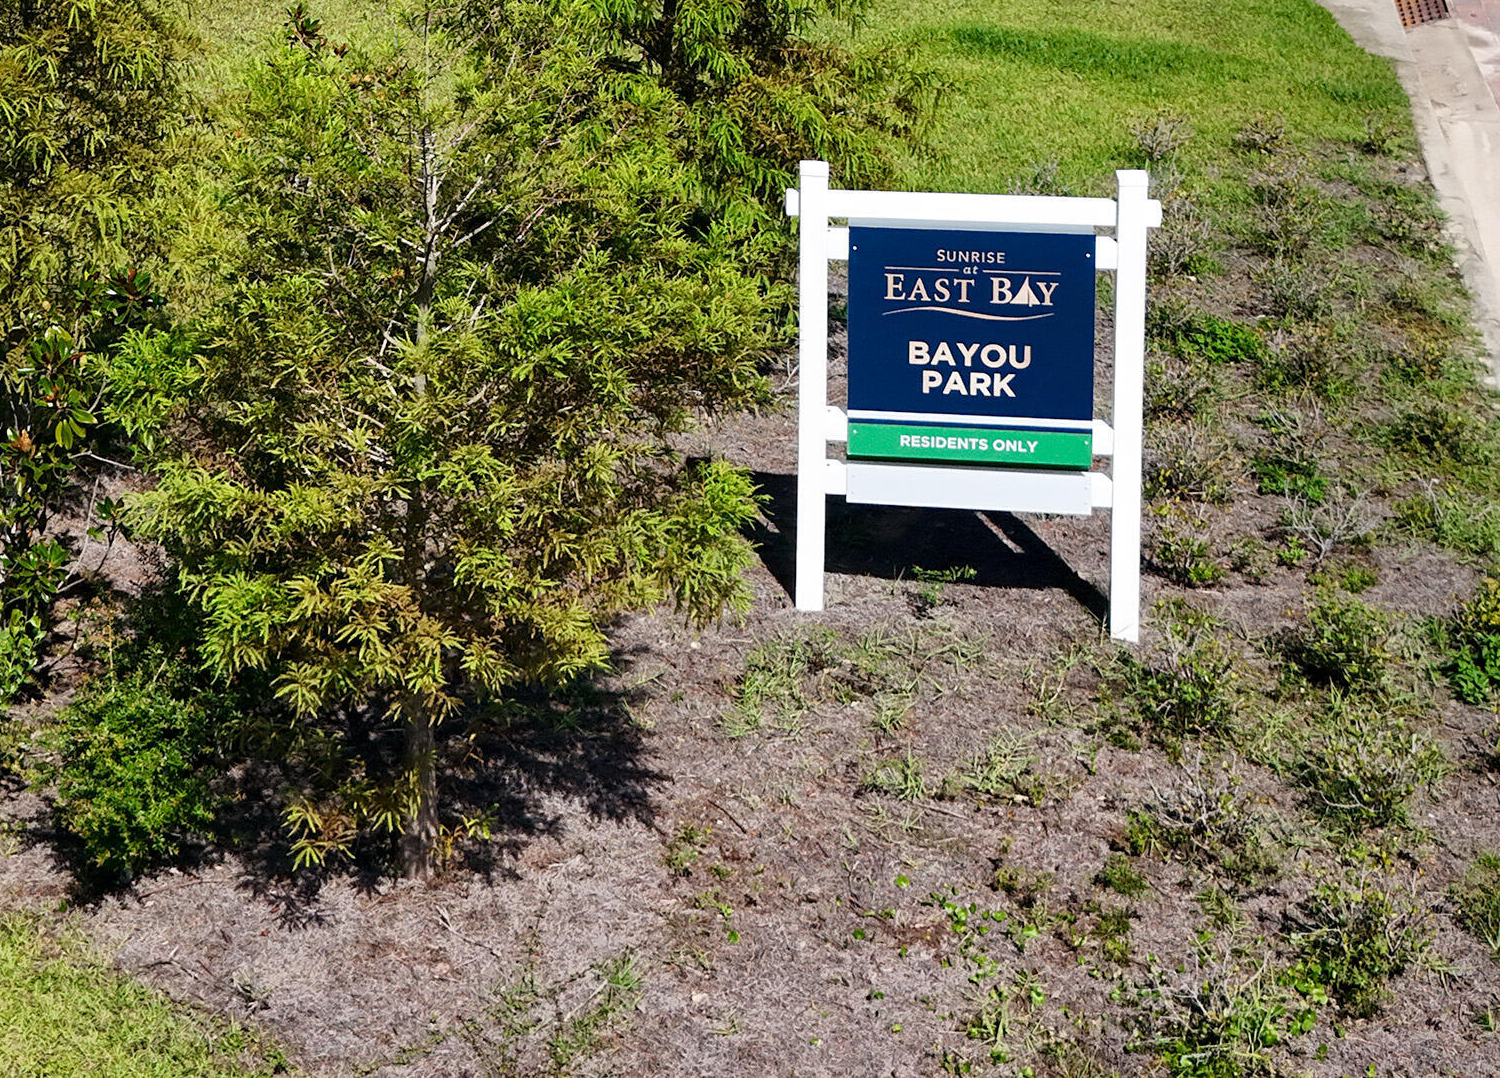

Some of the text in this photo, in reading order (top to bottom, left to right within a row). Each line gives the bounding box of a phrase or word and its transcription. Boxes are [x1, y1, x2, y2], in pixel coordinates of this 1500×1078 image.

[936, 248, 1006, 264] SUNRISE
[962, 265, 979, 275] at
[883, 272, 1060, 307] EAST BAY
[908, 340, 1032, 370] BAYOU
[921, 369, 1017, 398] PARK
[899, 434, 1039, 454] RESIDENTS ONLY
